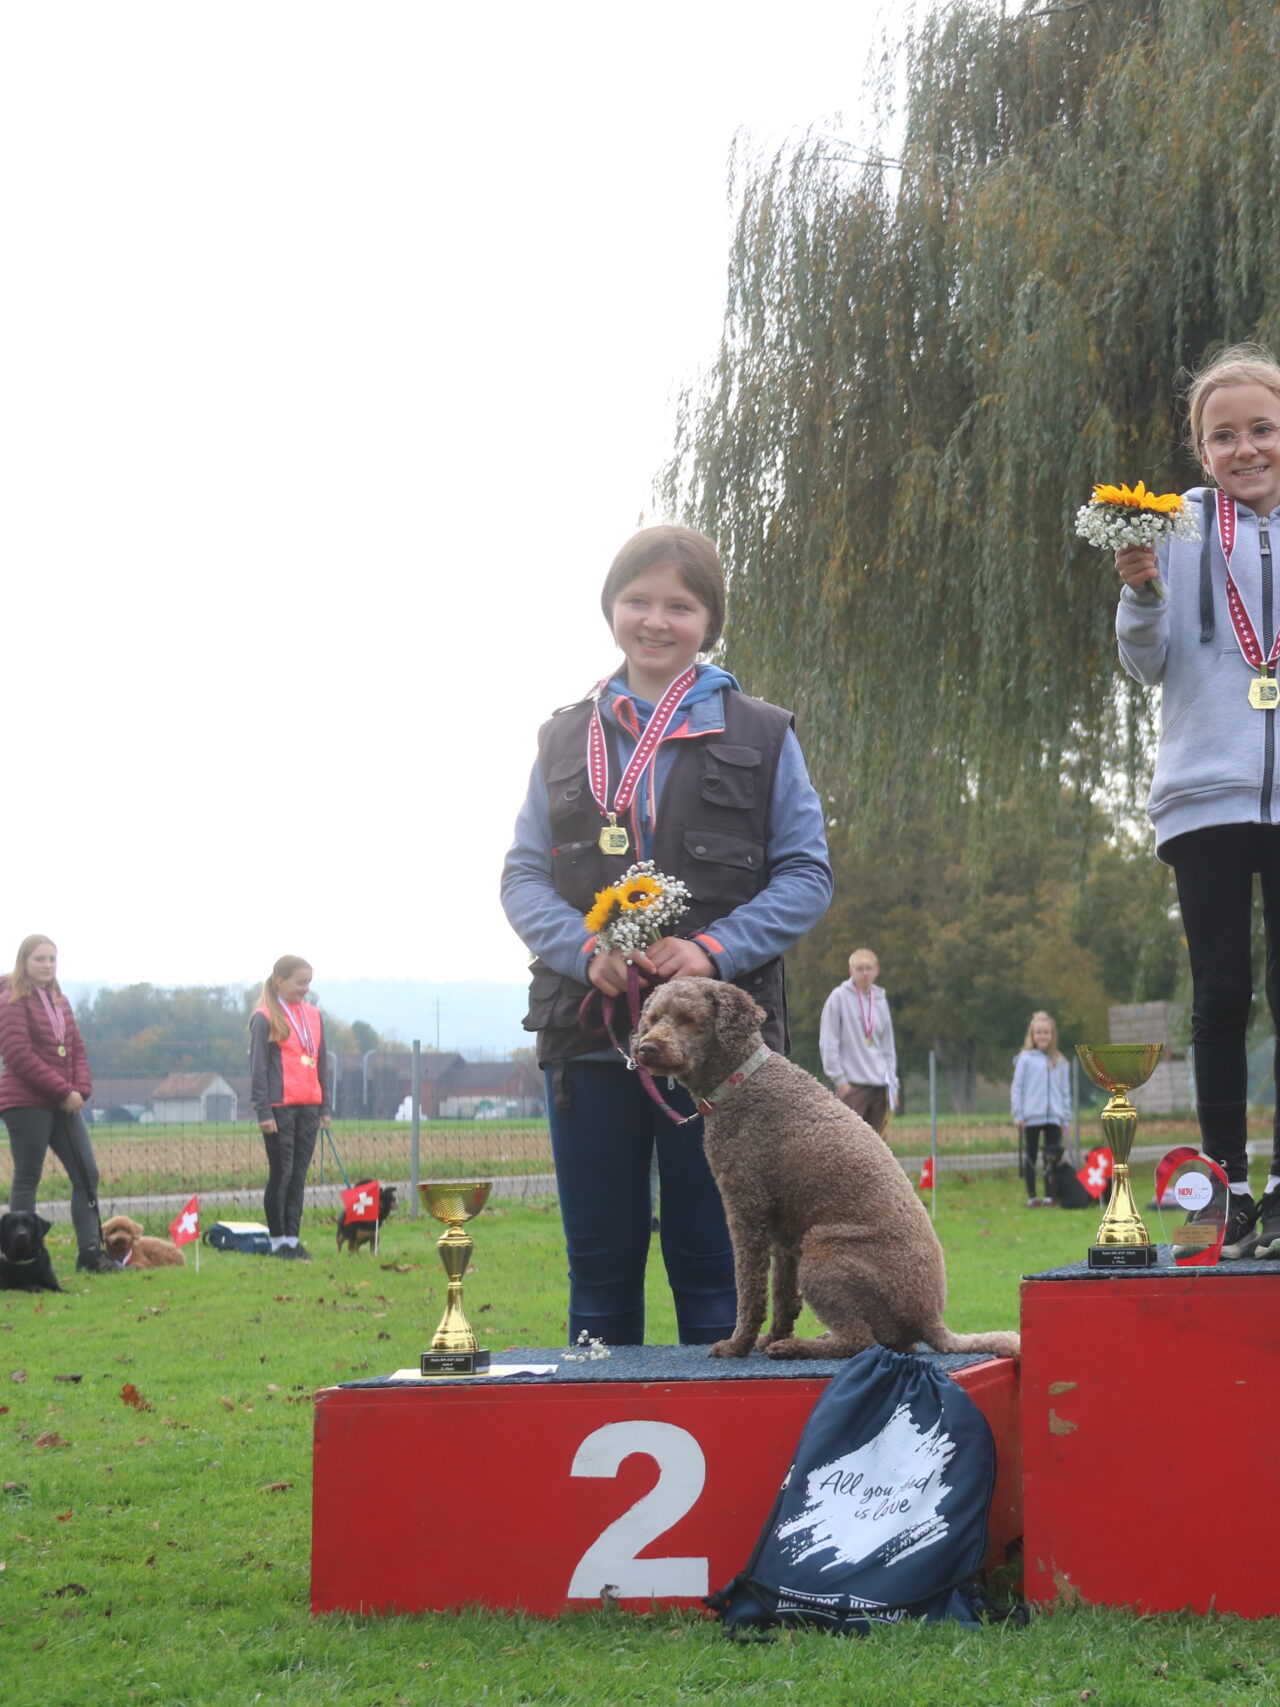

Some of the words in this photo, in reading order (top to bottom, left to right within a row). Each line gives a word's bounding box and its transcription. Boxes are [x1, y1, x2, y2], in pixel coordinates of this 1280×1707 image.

[820, 1470, 864, 1496] All
[860, 1486, 893, 1504] you
[567, 1420, 709, 1599] 2
[854, 1507, 871, 1520] is
[872, 1498, 911, 1521] love
